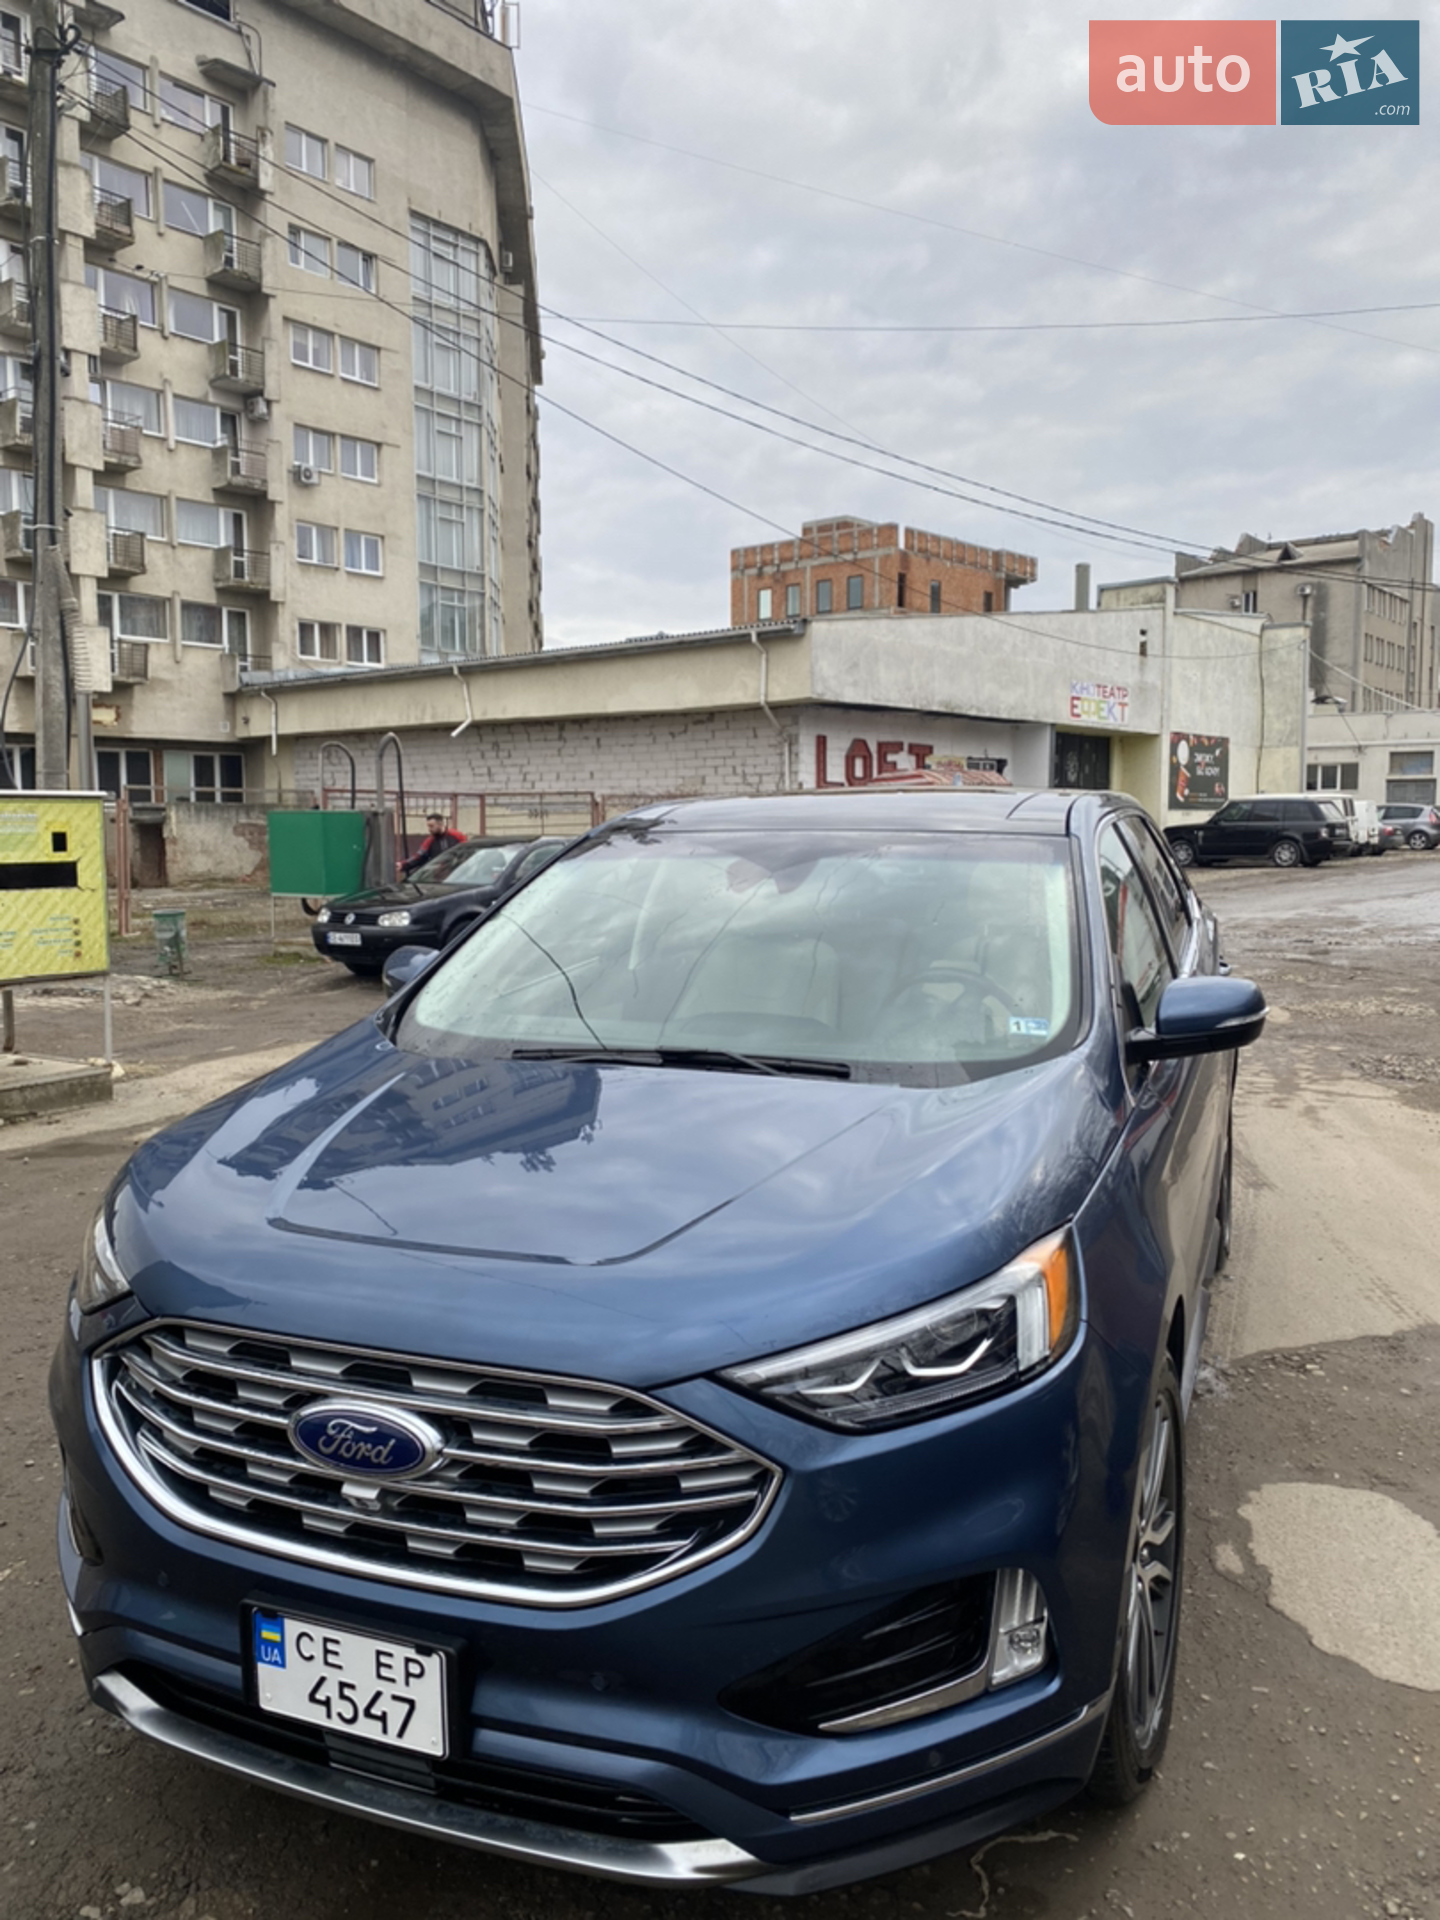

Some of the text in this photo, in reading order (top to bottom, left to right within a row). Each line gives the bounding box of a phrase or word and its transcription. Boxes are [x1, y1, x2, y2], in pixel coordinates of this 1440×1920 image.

[815, 734, 934, 788] LOFT
[317, 1418, 397, 1465] Ford
[260, 1645, 282, 1665] UA
[295, 1631, 426, 1687] CE EP
[308, 1675, 417, 1739] 4547
